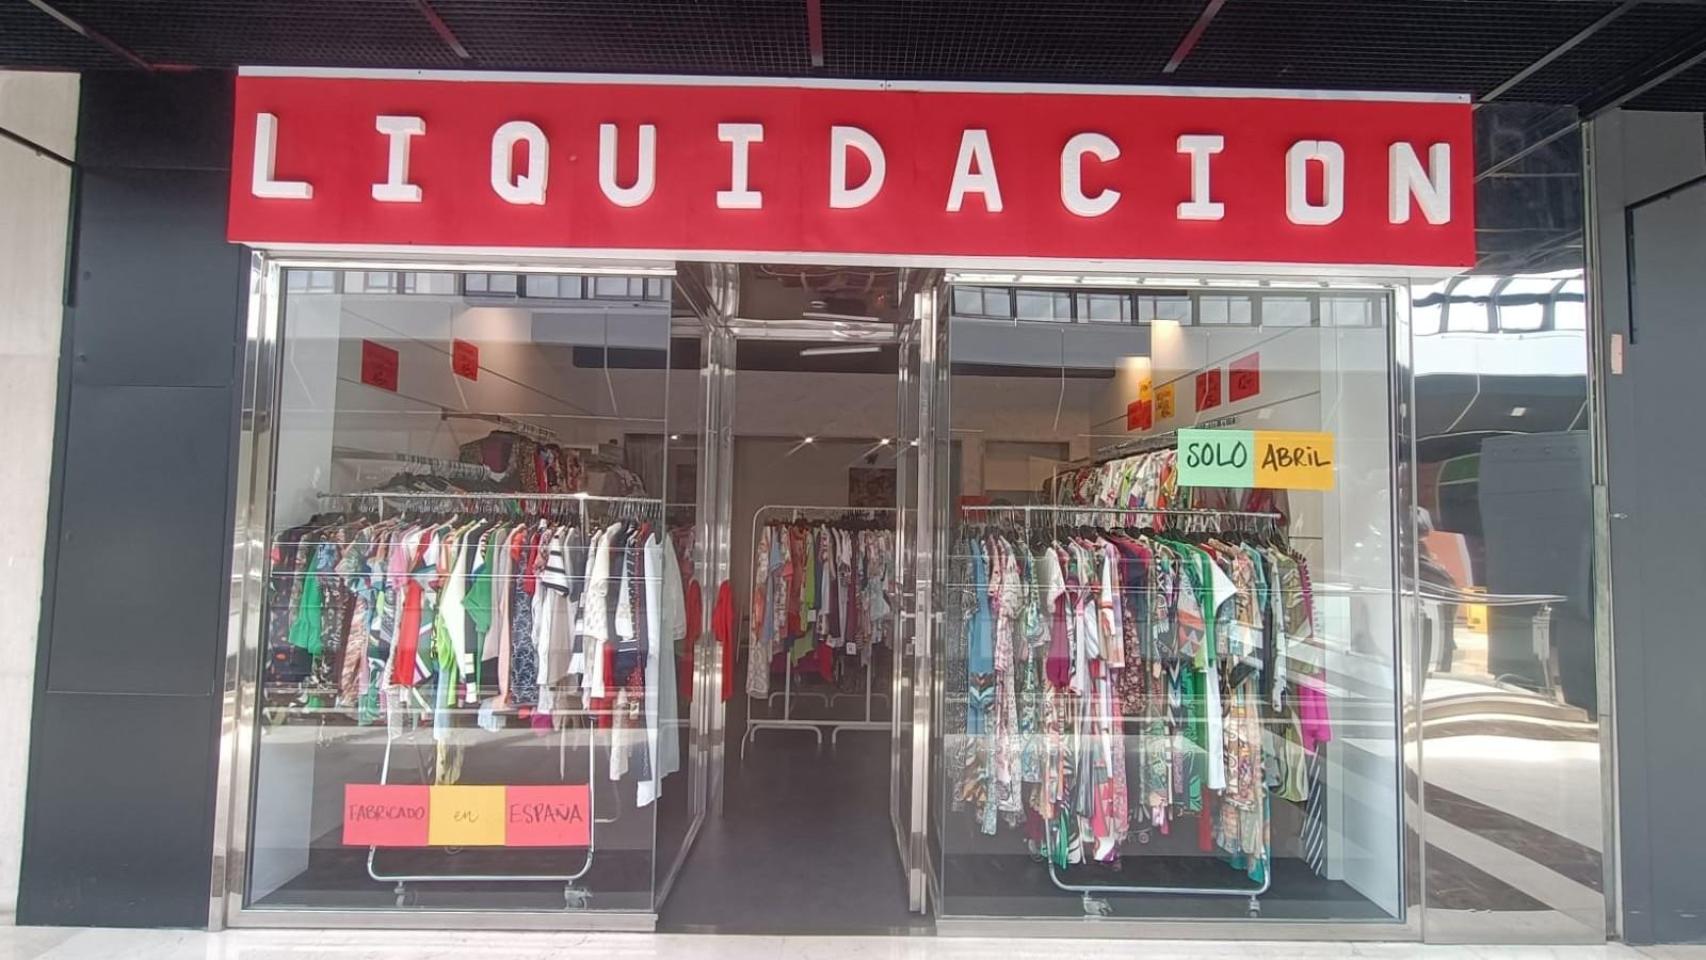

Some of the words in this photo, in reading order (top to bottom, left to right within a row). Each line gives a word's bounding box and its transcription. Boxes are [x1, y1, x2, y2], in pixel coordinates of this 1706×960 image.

[252, 112, 1451, 225] LIQUIDACION
[1187, 441, 1247, 468] SOLO
[453, 810, 479, 823] en
[509, 802, 583, 824] ESPAÑA
